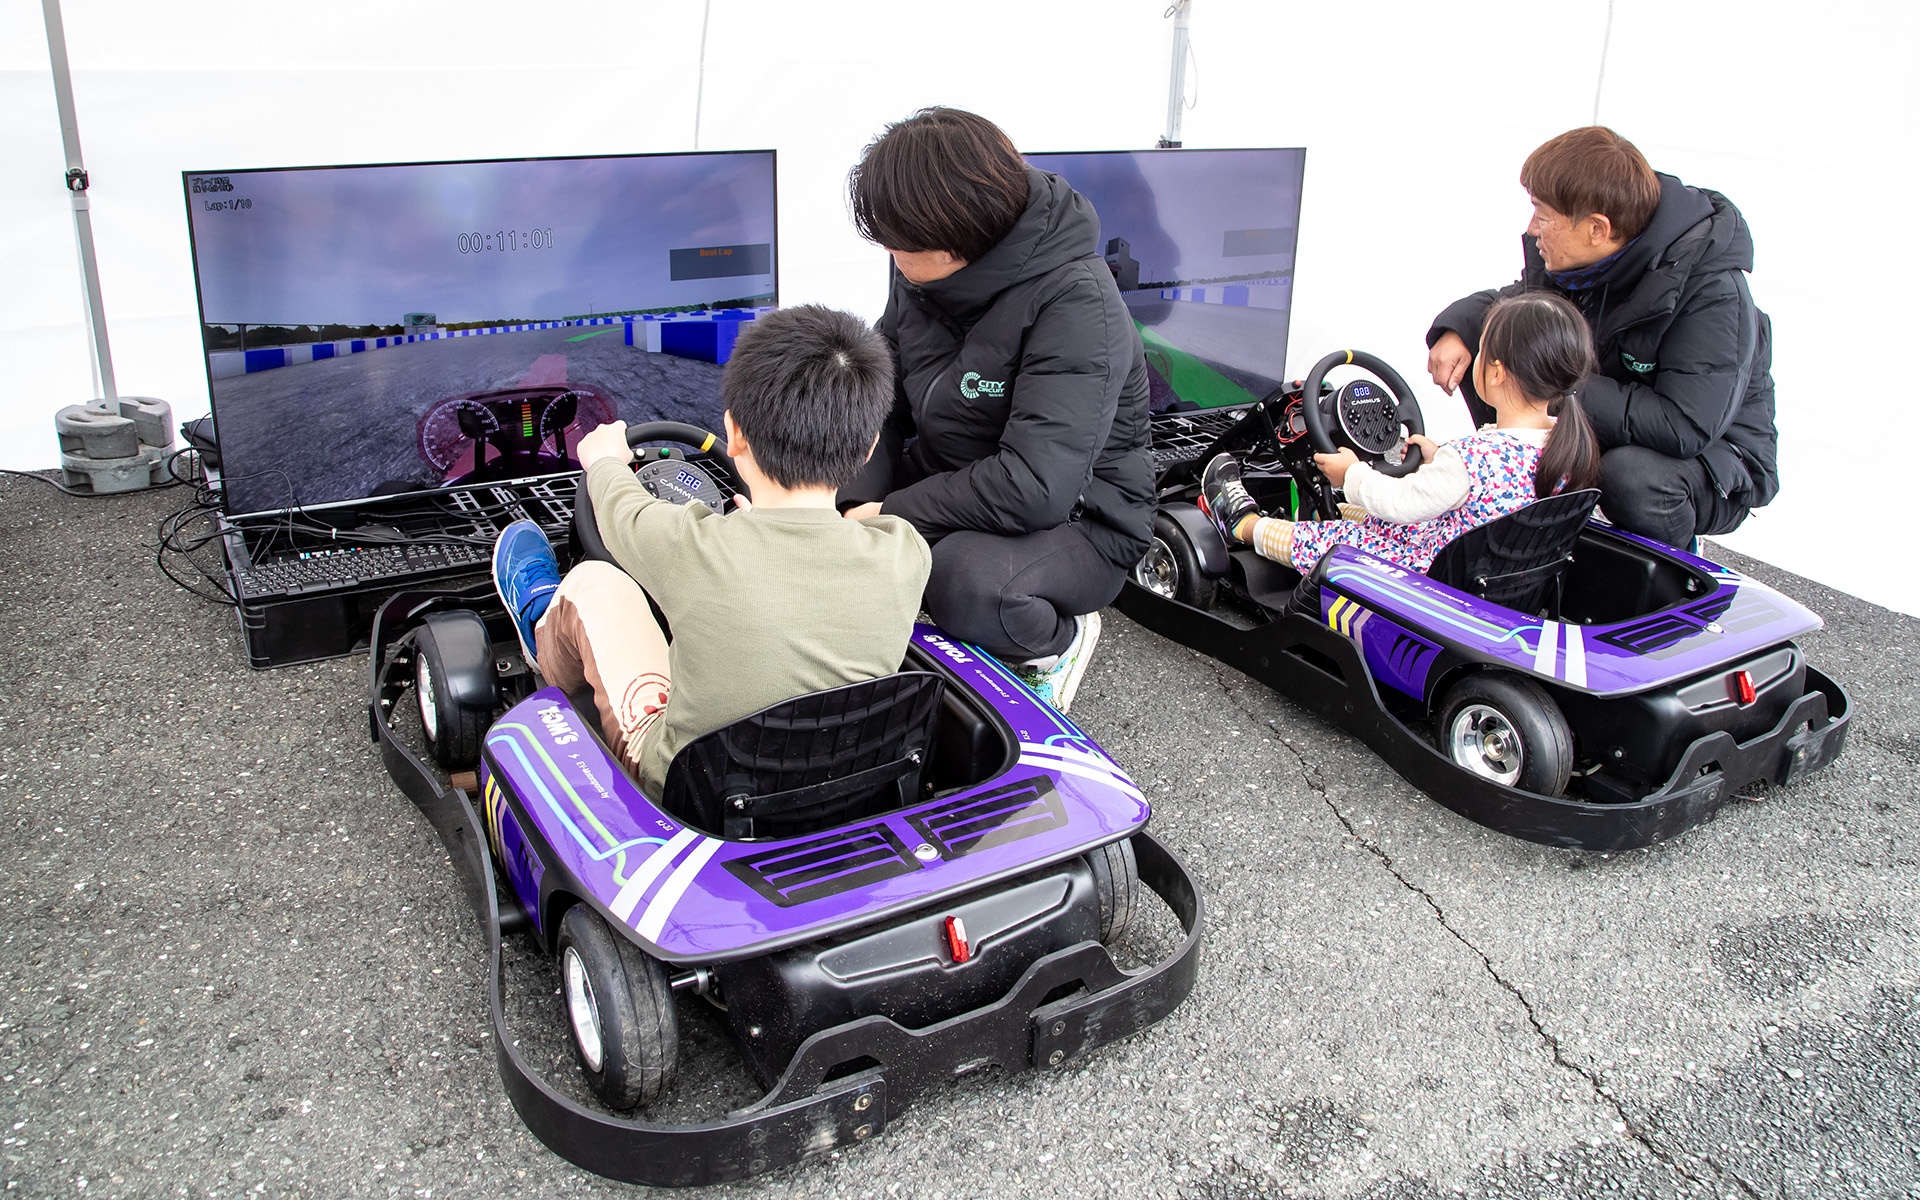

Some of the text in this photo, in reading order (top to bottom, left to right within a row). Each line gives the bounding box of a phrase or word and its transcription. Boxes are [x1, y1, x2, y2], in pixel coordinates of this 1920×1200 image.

[205, 199, 253, 211] Lap:1/10
[458, 228, 552, 254] 00:11:01
[700, 248, 733, 257] Best Lap
[978, 380, 1005, 388] CITY
[1351, 398, 1381, 406] CAMMUS
[537, 705, 580, 745] TOM'S
